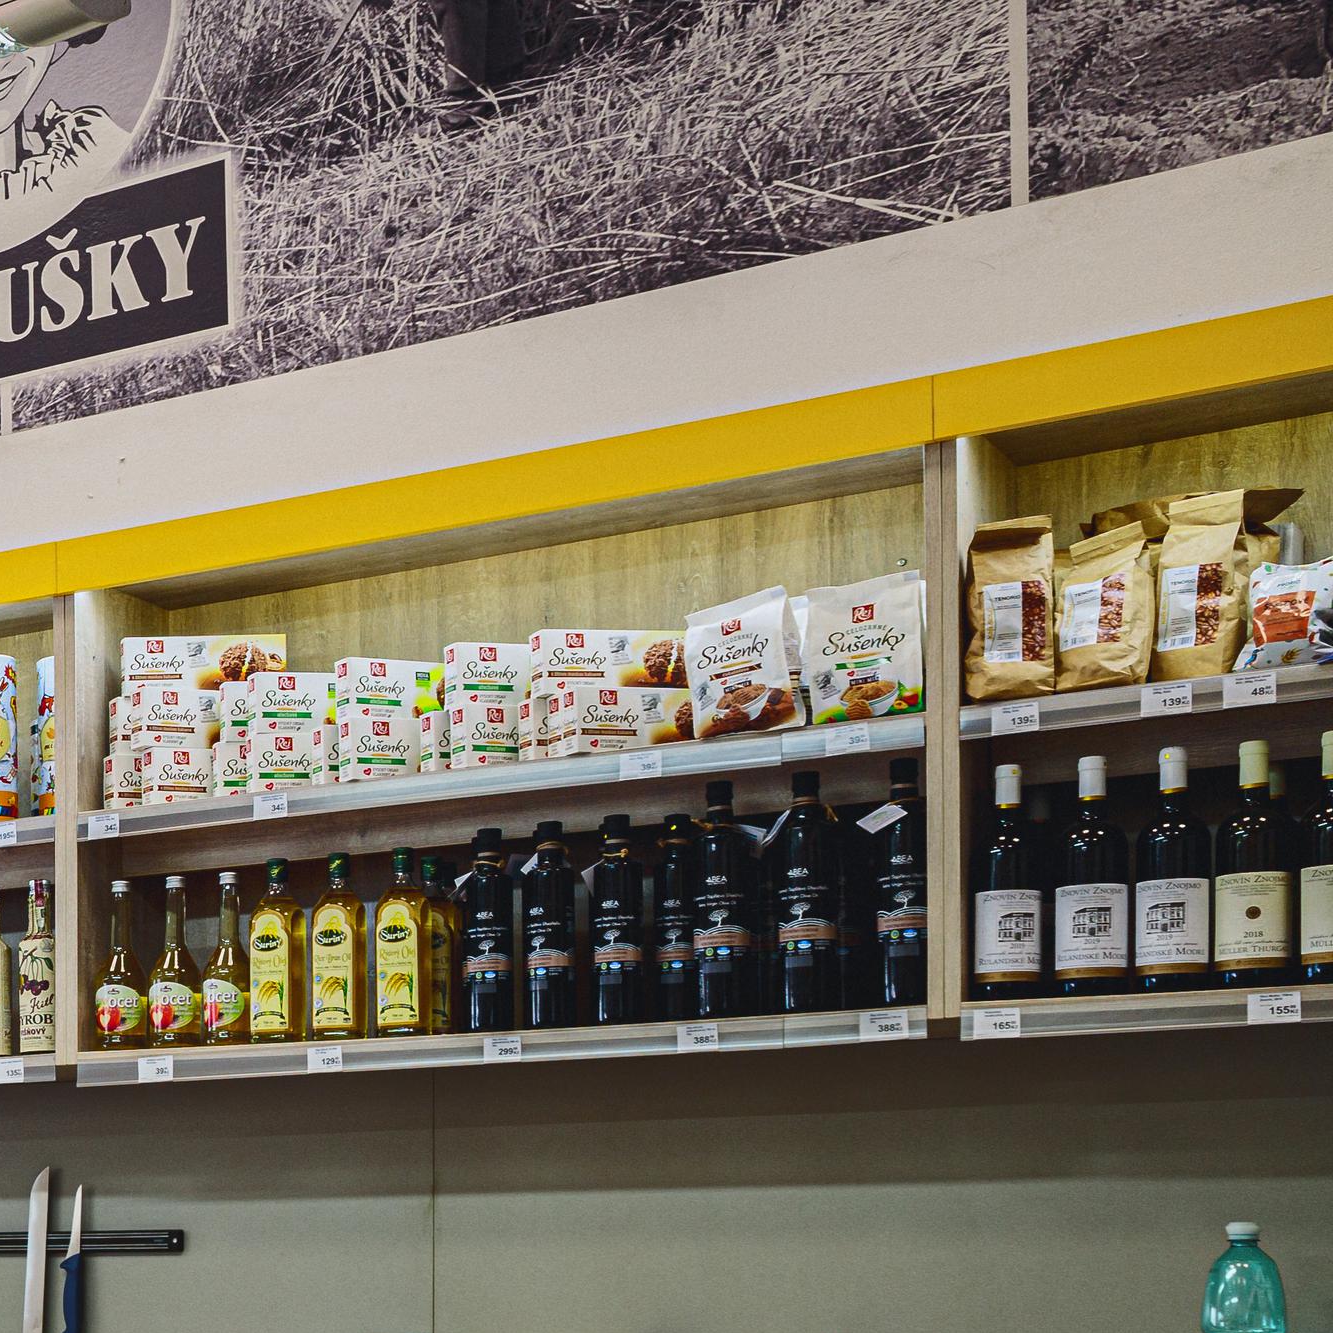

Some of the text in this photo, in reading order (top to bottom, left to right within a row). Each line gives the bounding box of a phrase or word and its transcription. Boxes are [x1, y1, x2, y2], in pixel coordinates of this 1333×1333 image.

[698, 634, 769, 670] Sušenky
[823, 628, 906, 656] Sušenky
[131, 654, 184, 671] Sušenky
[549, 648, 606, 669] Sušenky
[463, 662, 518, 682] Sušenky
[356, 676, 405, 697] Sušenky
[1251, 688, 1265, 696] 48
[262, 690, 316, 711] Sušenky
[1161, 698, 1181, 707] 139
[148, 704, 196, 725] Sušenky
[583, 705, 638, 727] Sušenky
[357, 735, 409, 756] Sušenky
[159, 764, 208, 784] Sušenky
[253, 938, 283, 950] Suriny
[315, 933, 346, 945] Suriny
[380, 928, 410, 940] Suriny
[30, 994, 53, 1014] Kitl
[108, 997, 139, 1007] ocet
[161, 994, 192, 1005] ocet
[207, 991, 237, 1002] ocet
[1269, 1006, 1290, 1015] 155
